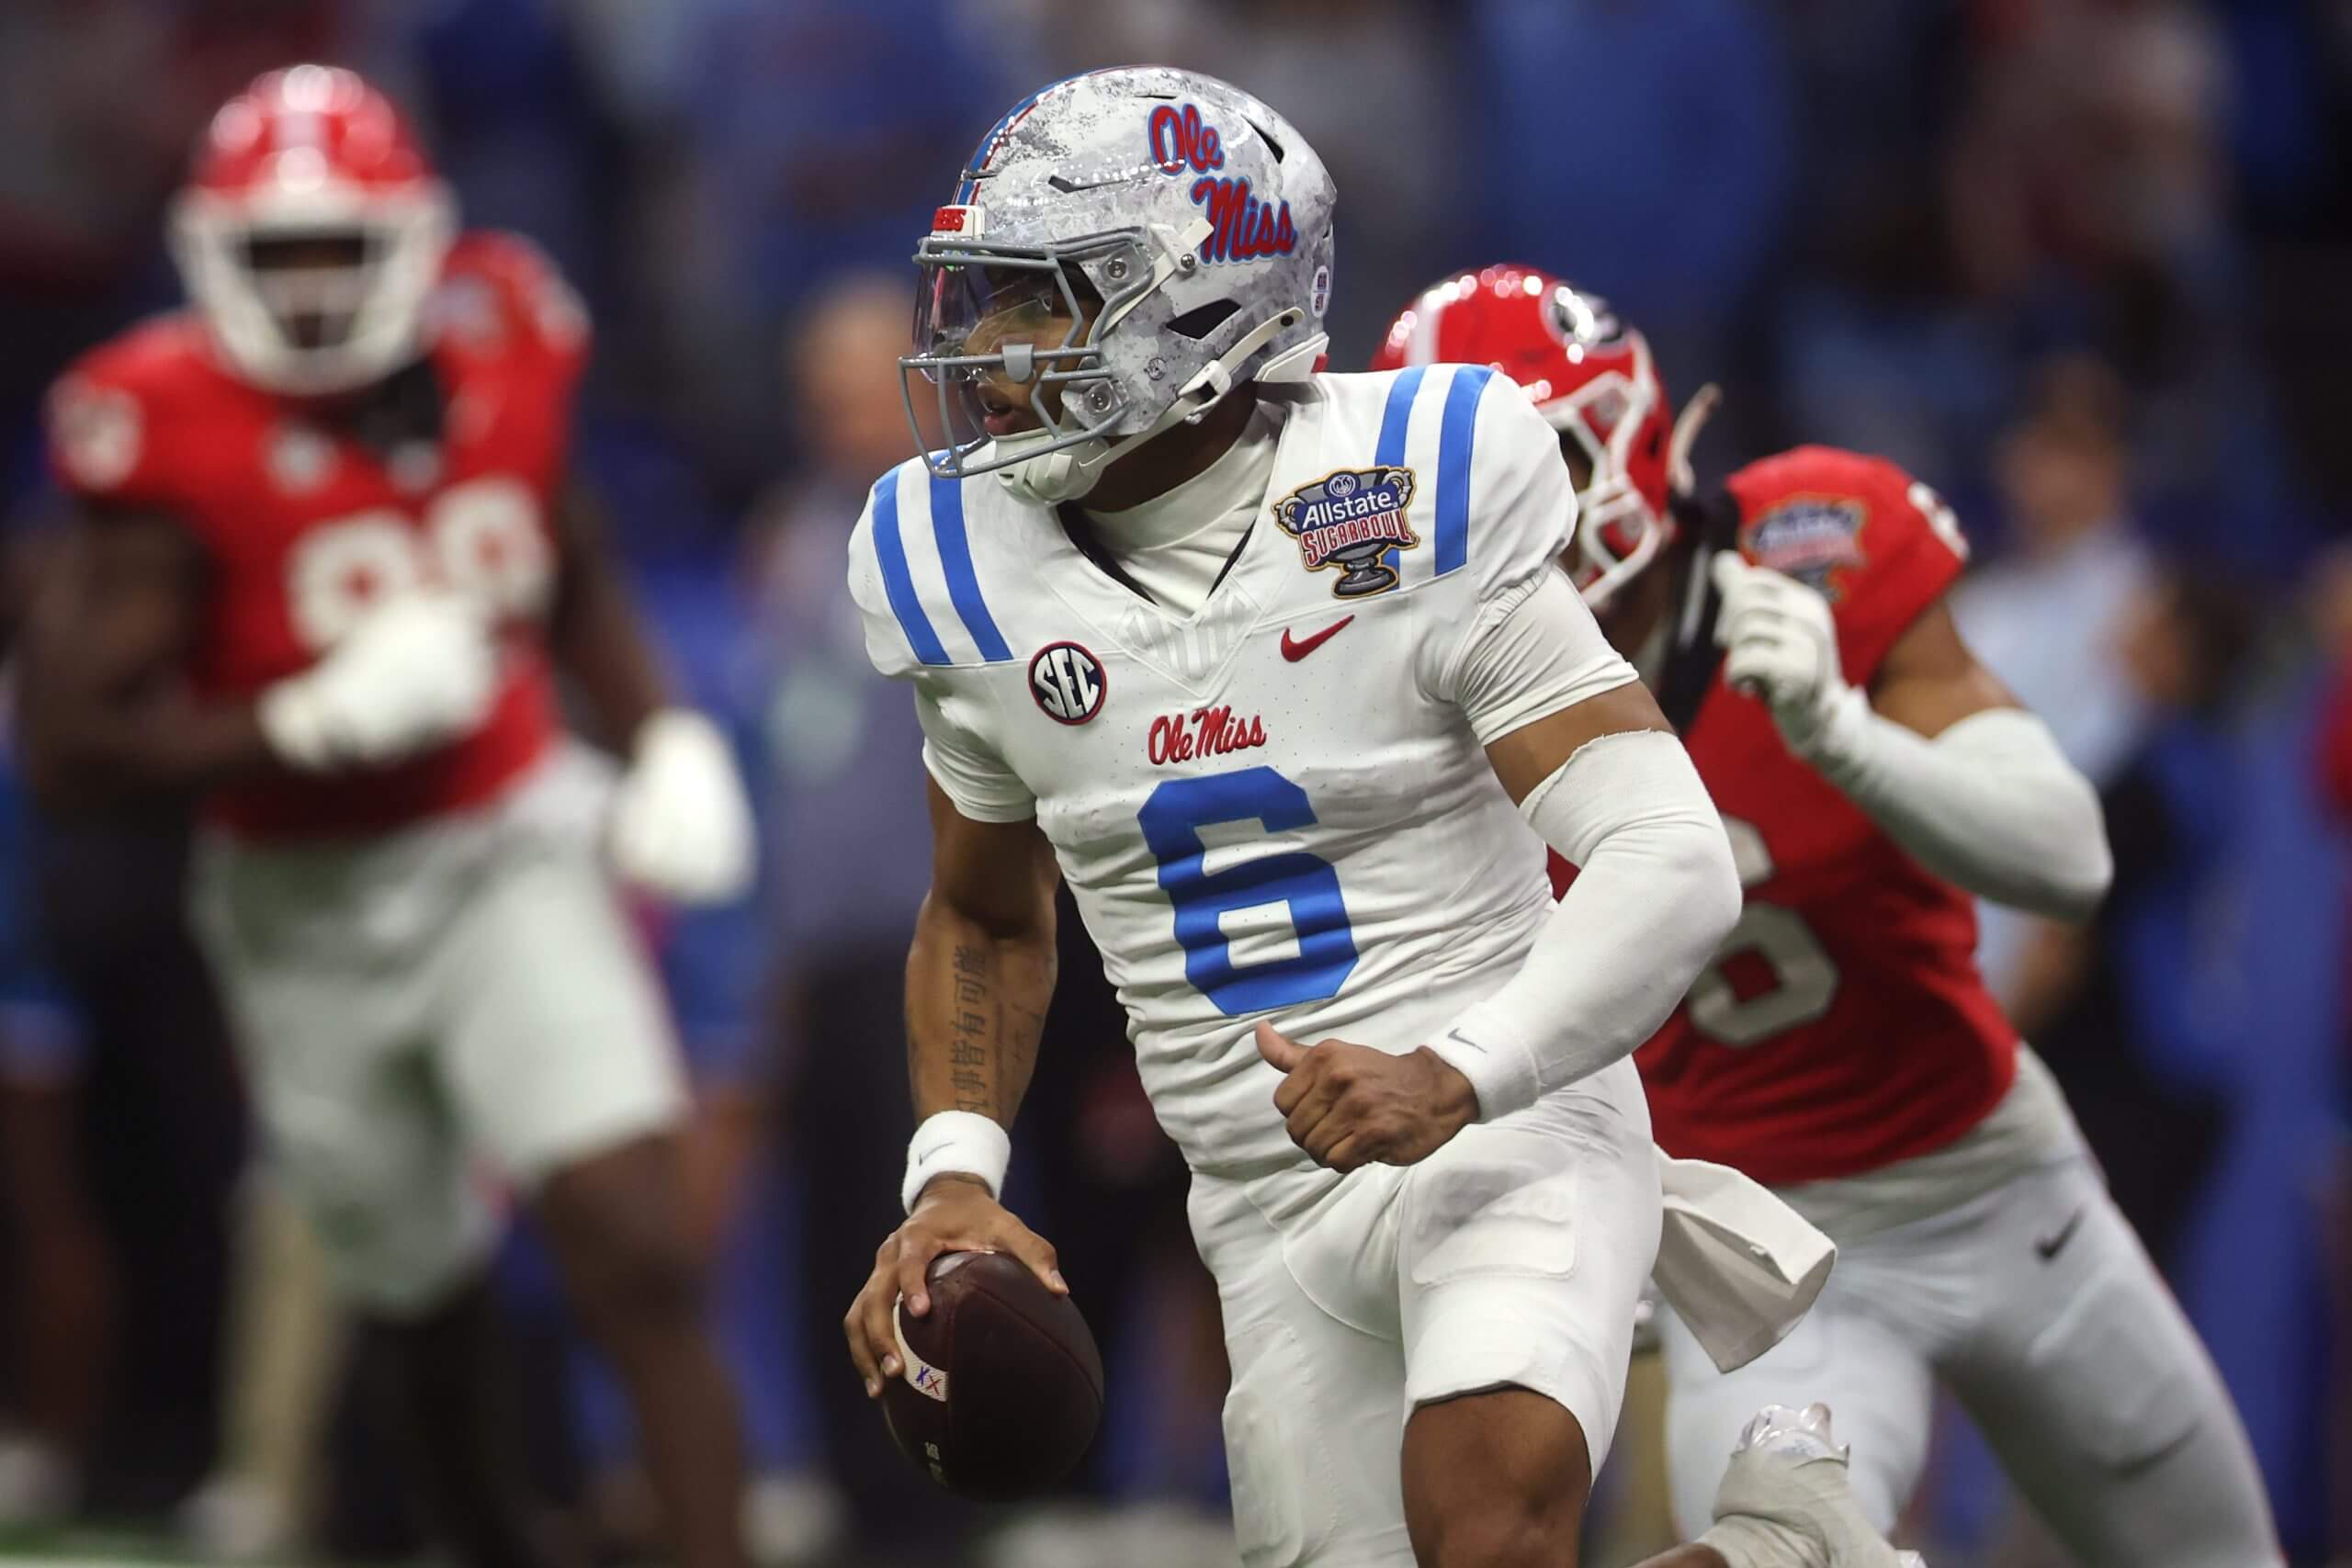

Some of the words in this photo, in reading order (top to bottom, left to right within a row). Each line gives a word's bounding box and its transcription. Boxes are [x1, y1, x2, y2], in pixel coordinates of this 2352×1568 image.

[1148, 103, 1225, 176] Ole
[1191, 176, 1299, 265] Miss
[1302, 491, 1392, 530] Allstate
[1035, 648, 1100, 718] SEC
[1148, 716, 1193, 765] Ole
[1193, 705, 1267, 758] Miss
[1136, 766, 1360, 1018] 6
